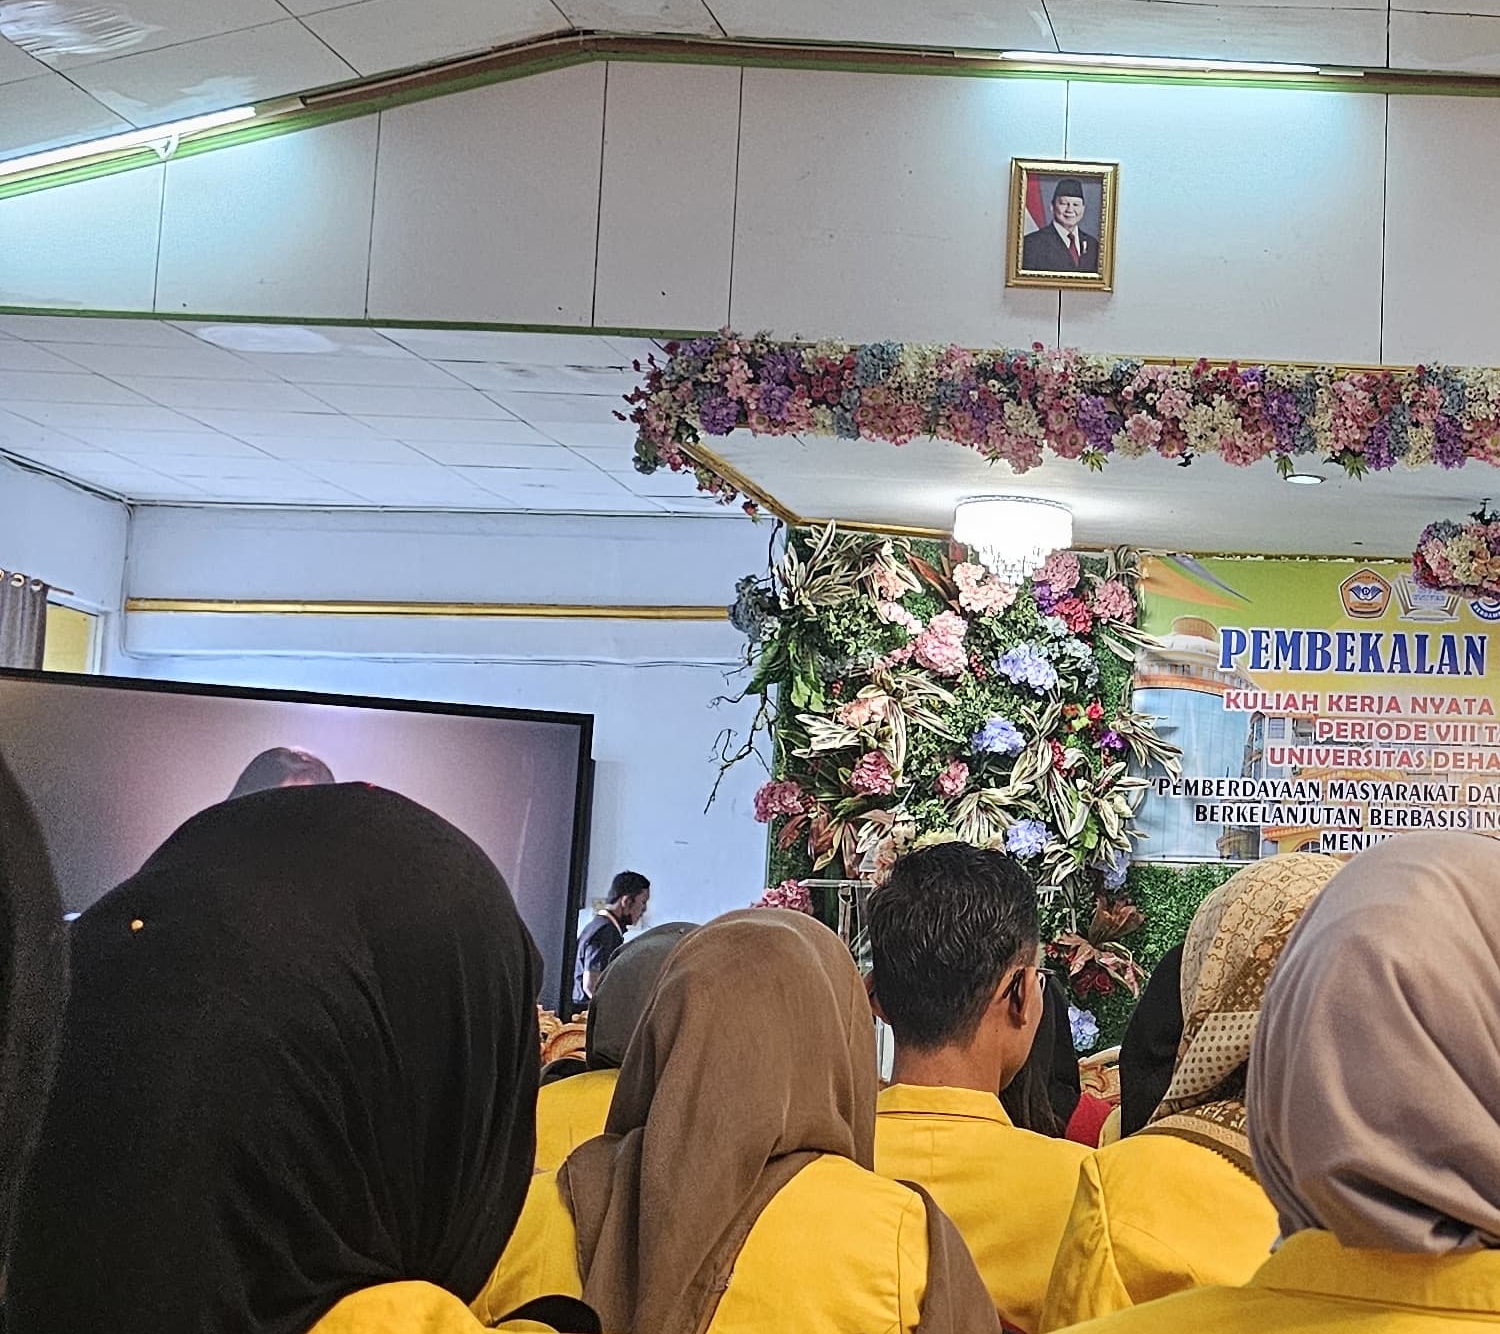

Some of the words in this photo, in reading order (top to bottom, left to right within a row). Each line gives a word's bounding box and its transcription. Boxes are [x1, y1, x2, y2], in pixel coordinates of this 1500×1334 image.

[1220, 629, 1486, 676] PEMBEKALAN
[1225, 692, 1318, 712] KULIAH
[1328, 694, 1400, 714] KERJA
[1410, 696, 1494, 716] NYATA
[1318, 722, 1427, 741] PERIODE
[1436, 724, 1476, 743] VIII
[1270, 748, 1425, 768] UNIVERSITAS
[1149, 778, 1320, 799] “PEMBERDAYAAN
[1329, 783, 1459, 802] MASYARAKAT
[1196, 805, 1361, 825] BERKELANJUTAN
[1370, 809, 1467, 828] BERBASIS
[1322, 833, 1393, 851] MENU
